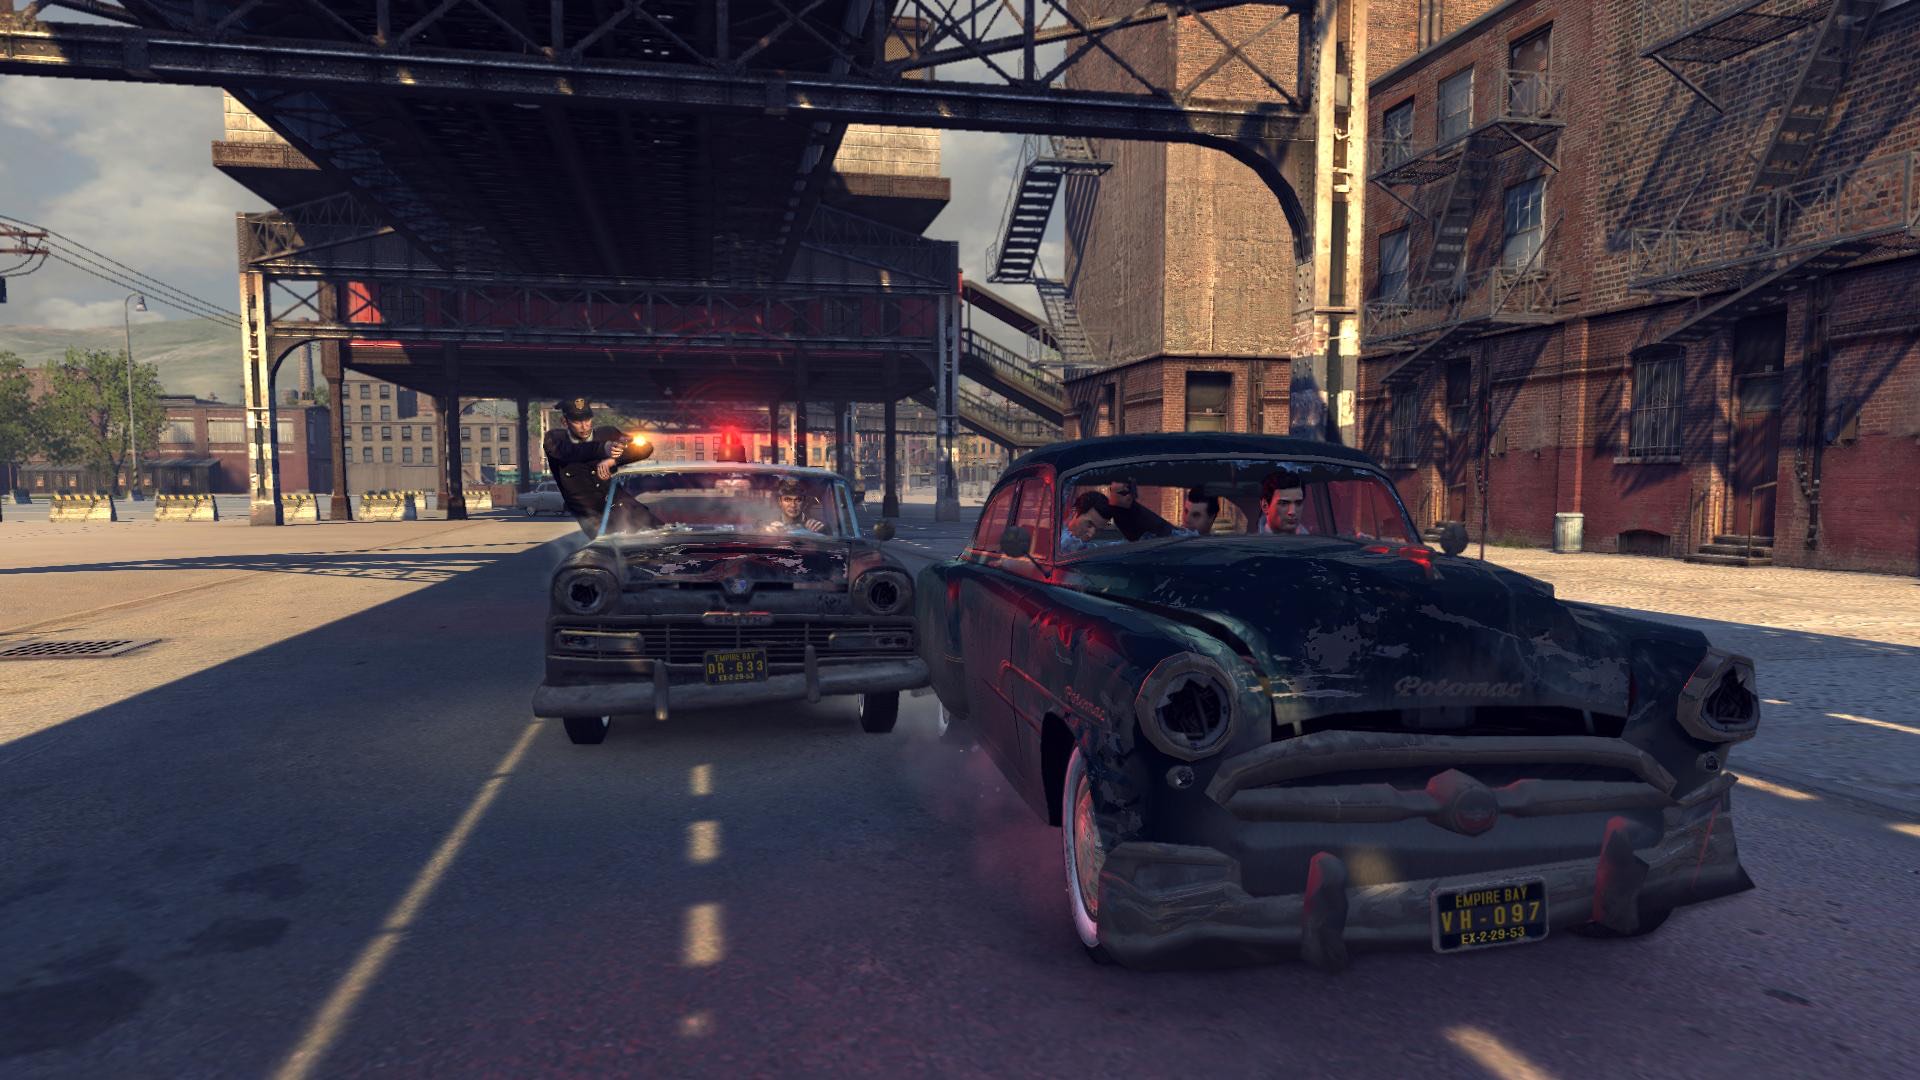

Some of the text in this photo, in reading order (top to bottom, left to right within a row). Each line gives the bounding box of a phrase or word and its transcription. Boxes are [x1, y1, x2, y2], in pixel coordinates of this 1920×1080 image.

[1394, 675, 1523, 697] Potomac
[1455, 886, 1527, 909] EMPIRE BAY
[1461, 926, 1526, 945] EX-2-29-53
